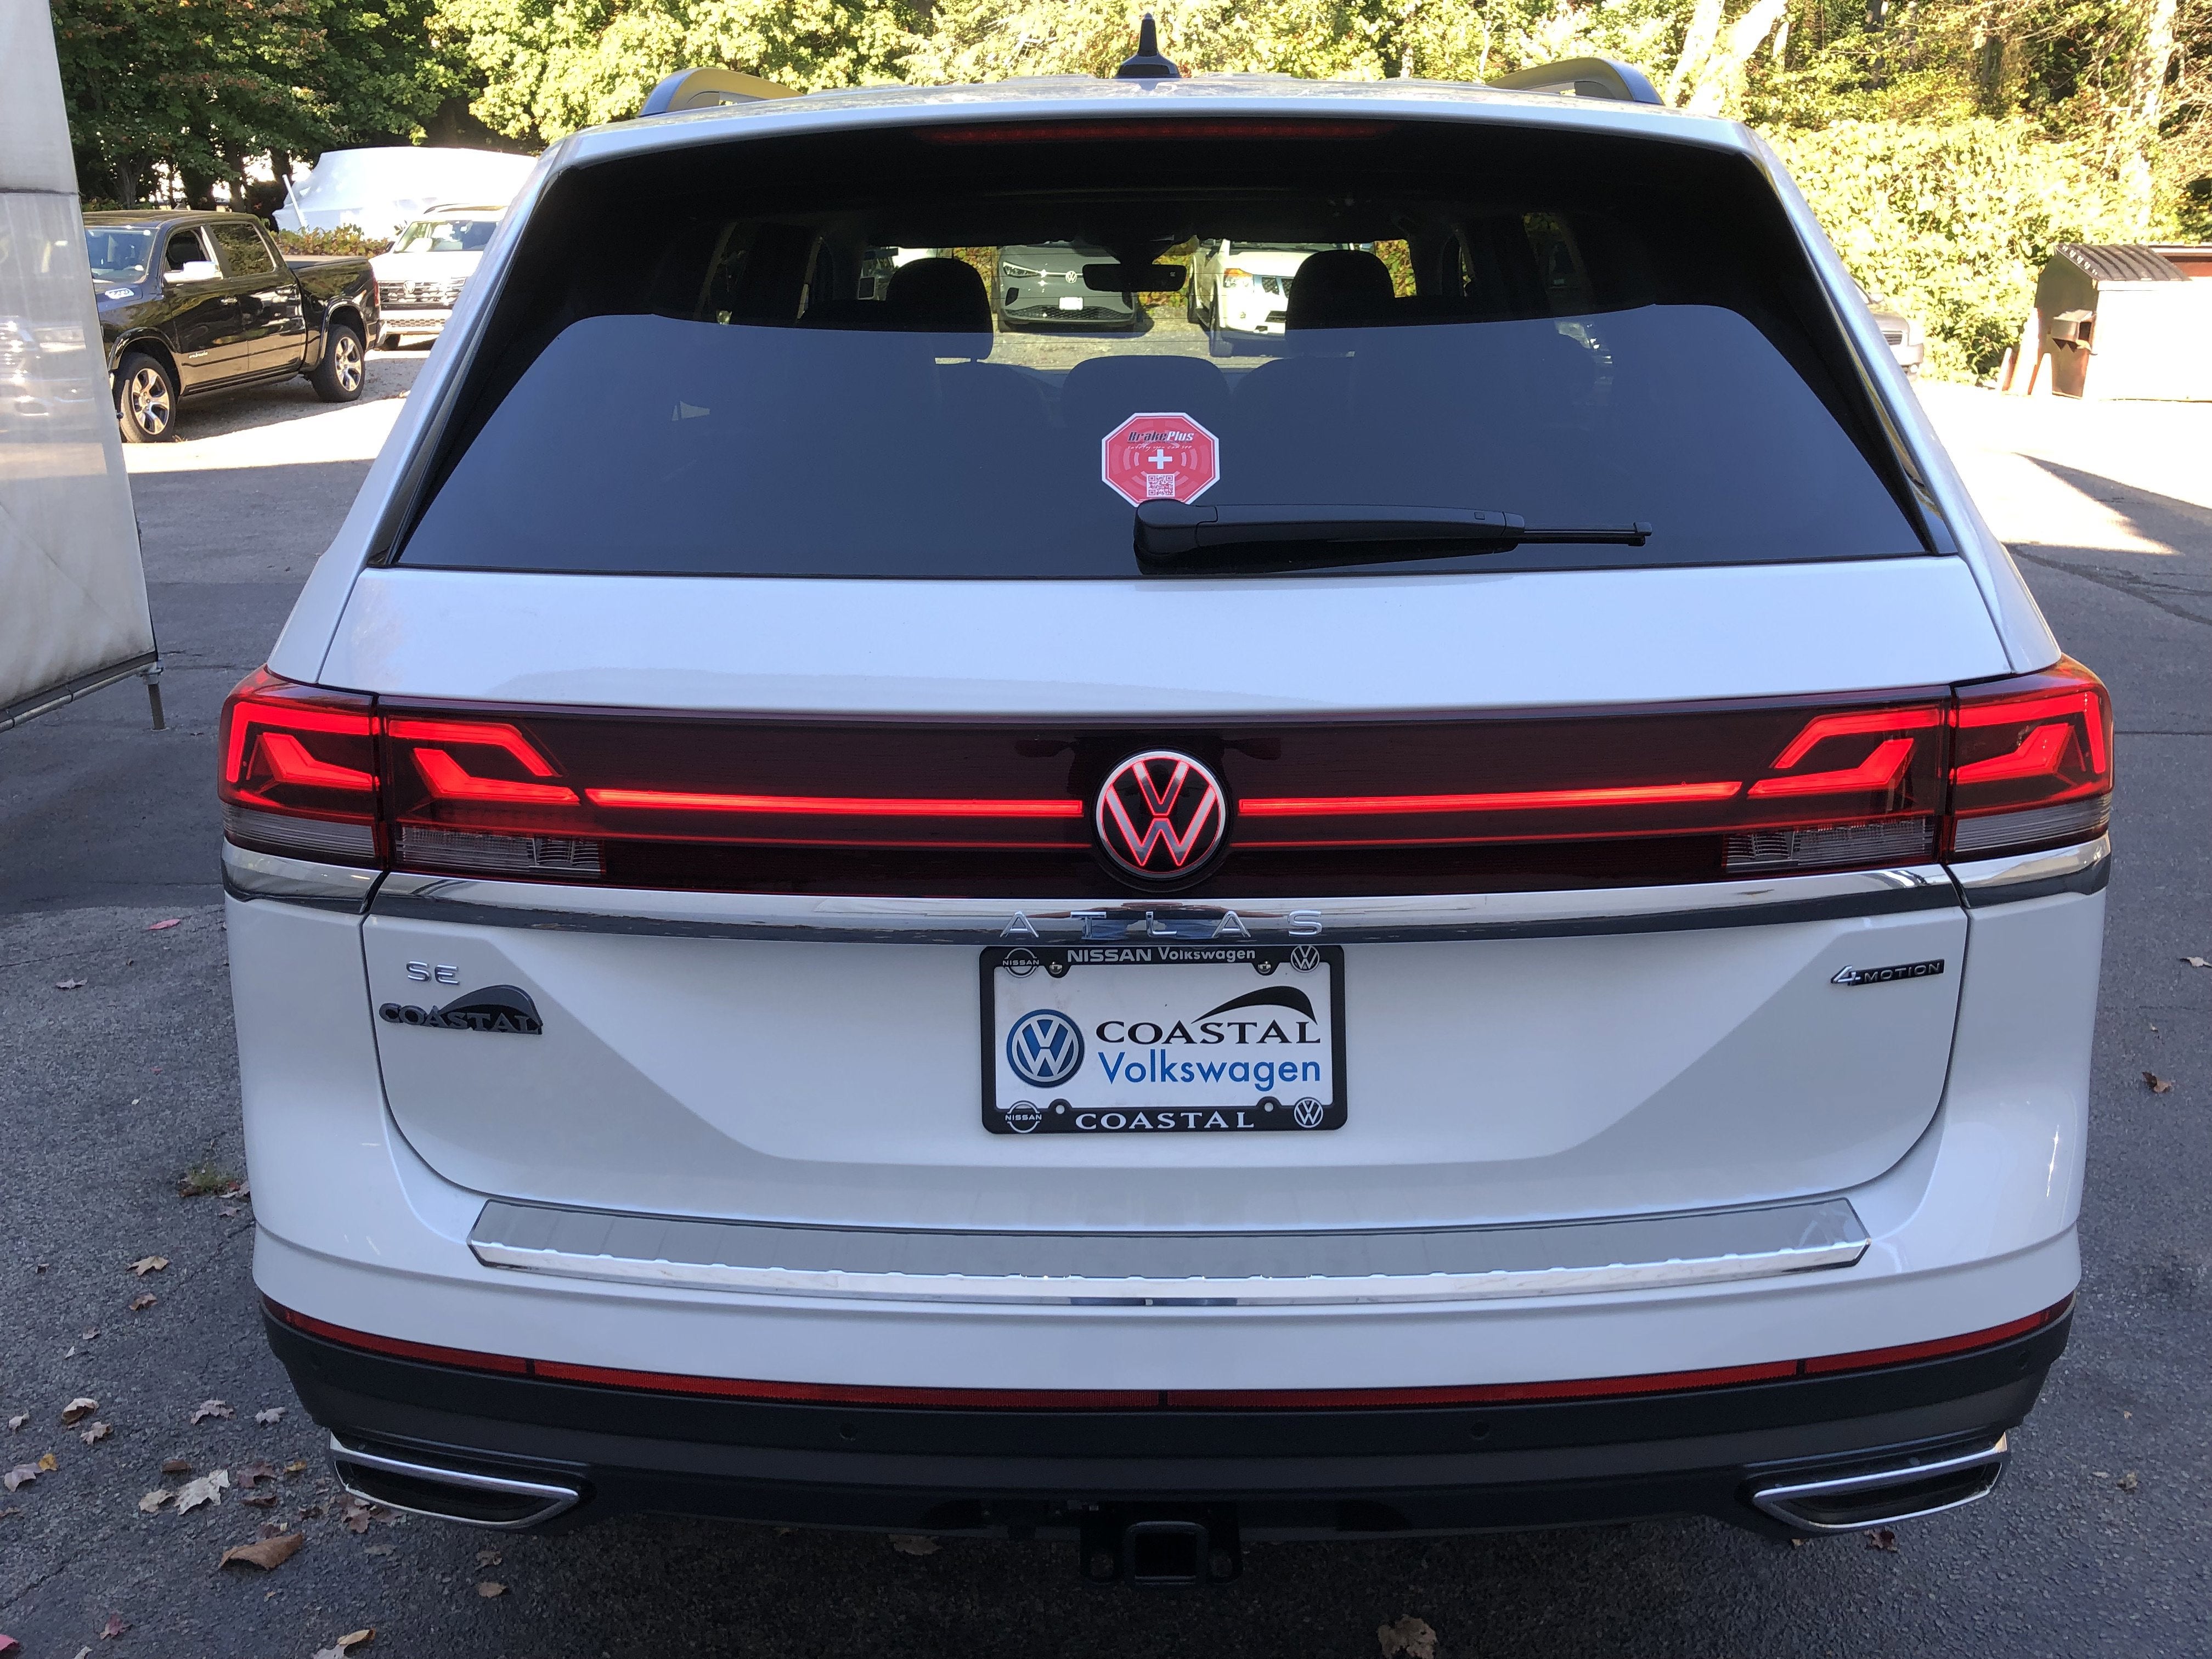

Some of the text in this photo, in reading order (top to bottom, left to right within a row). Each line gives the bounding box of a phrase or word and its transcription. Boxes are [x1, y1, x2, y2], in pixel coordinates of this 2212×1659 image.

[1128, 431, 1194, 442] BrakePlus
[1104, 758, 1218, 867] VW
[1000, 910, 1322, 939] ATLAS
[1067, 946, 1255, 963] NISSAN Volkswagen
[406, 961, 460, 985] SE
[1831, 962, 1940, 986] 4MOTION
[379, 1003, 541, 1035] COASTAL
[1096, 1019, 1321, 1045] COASTAL
[1098, 1048, 1321, 1091] Volkswagen
[1075, 1111, 1254, 1130] COASTAL
